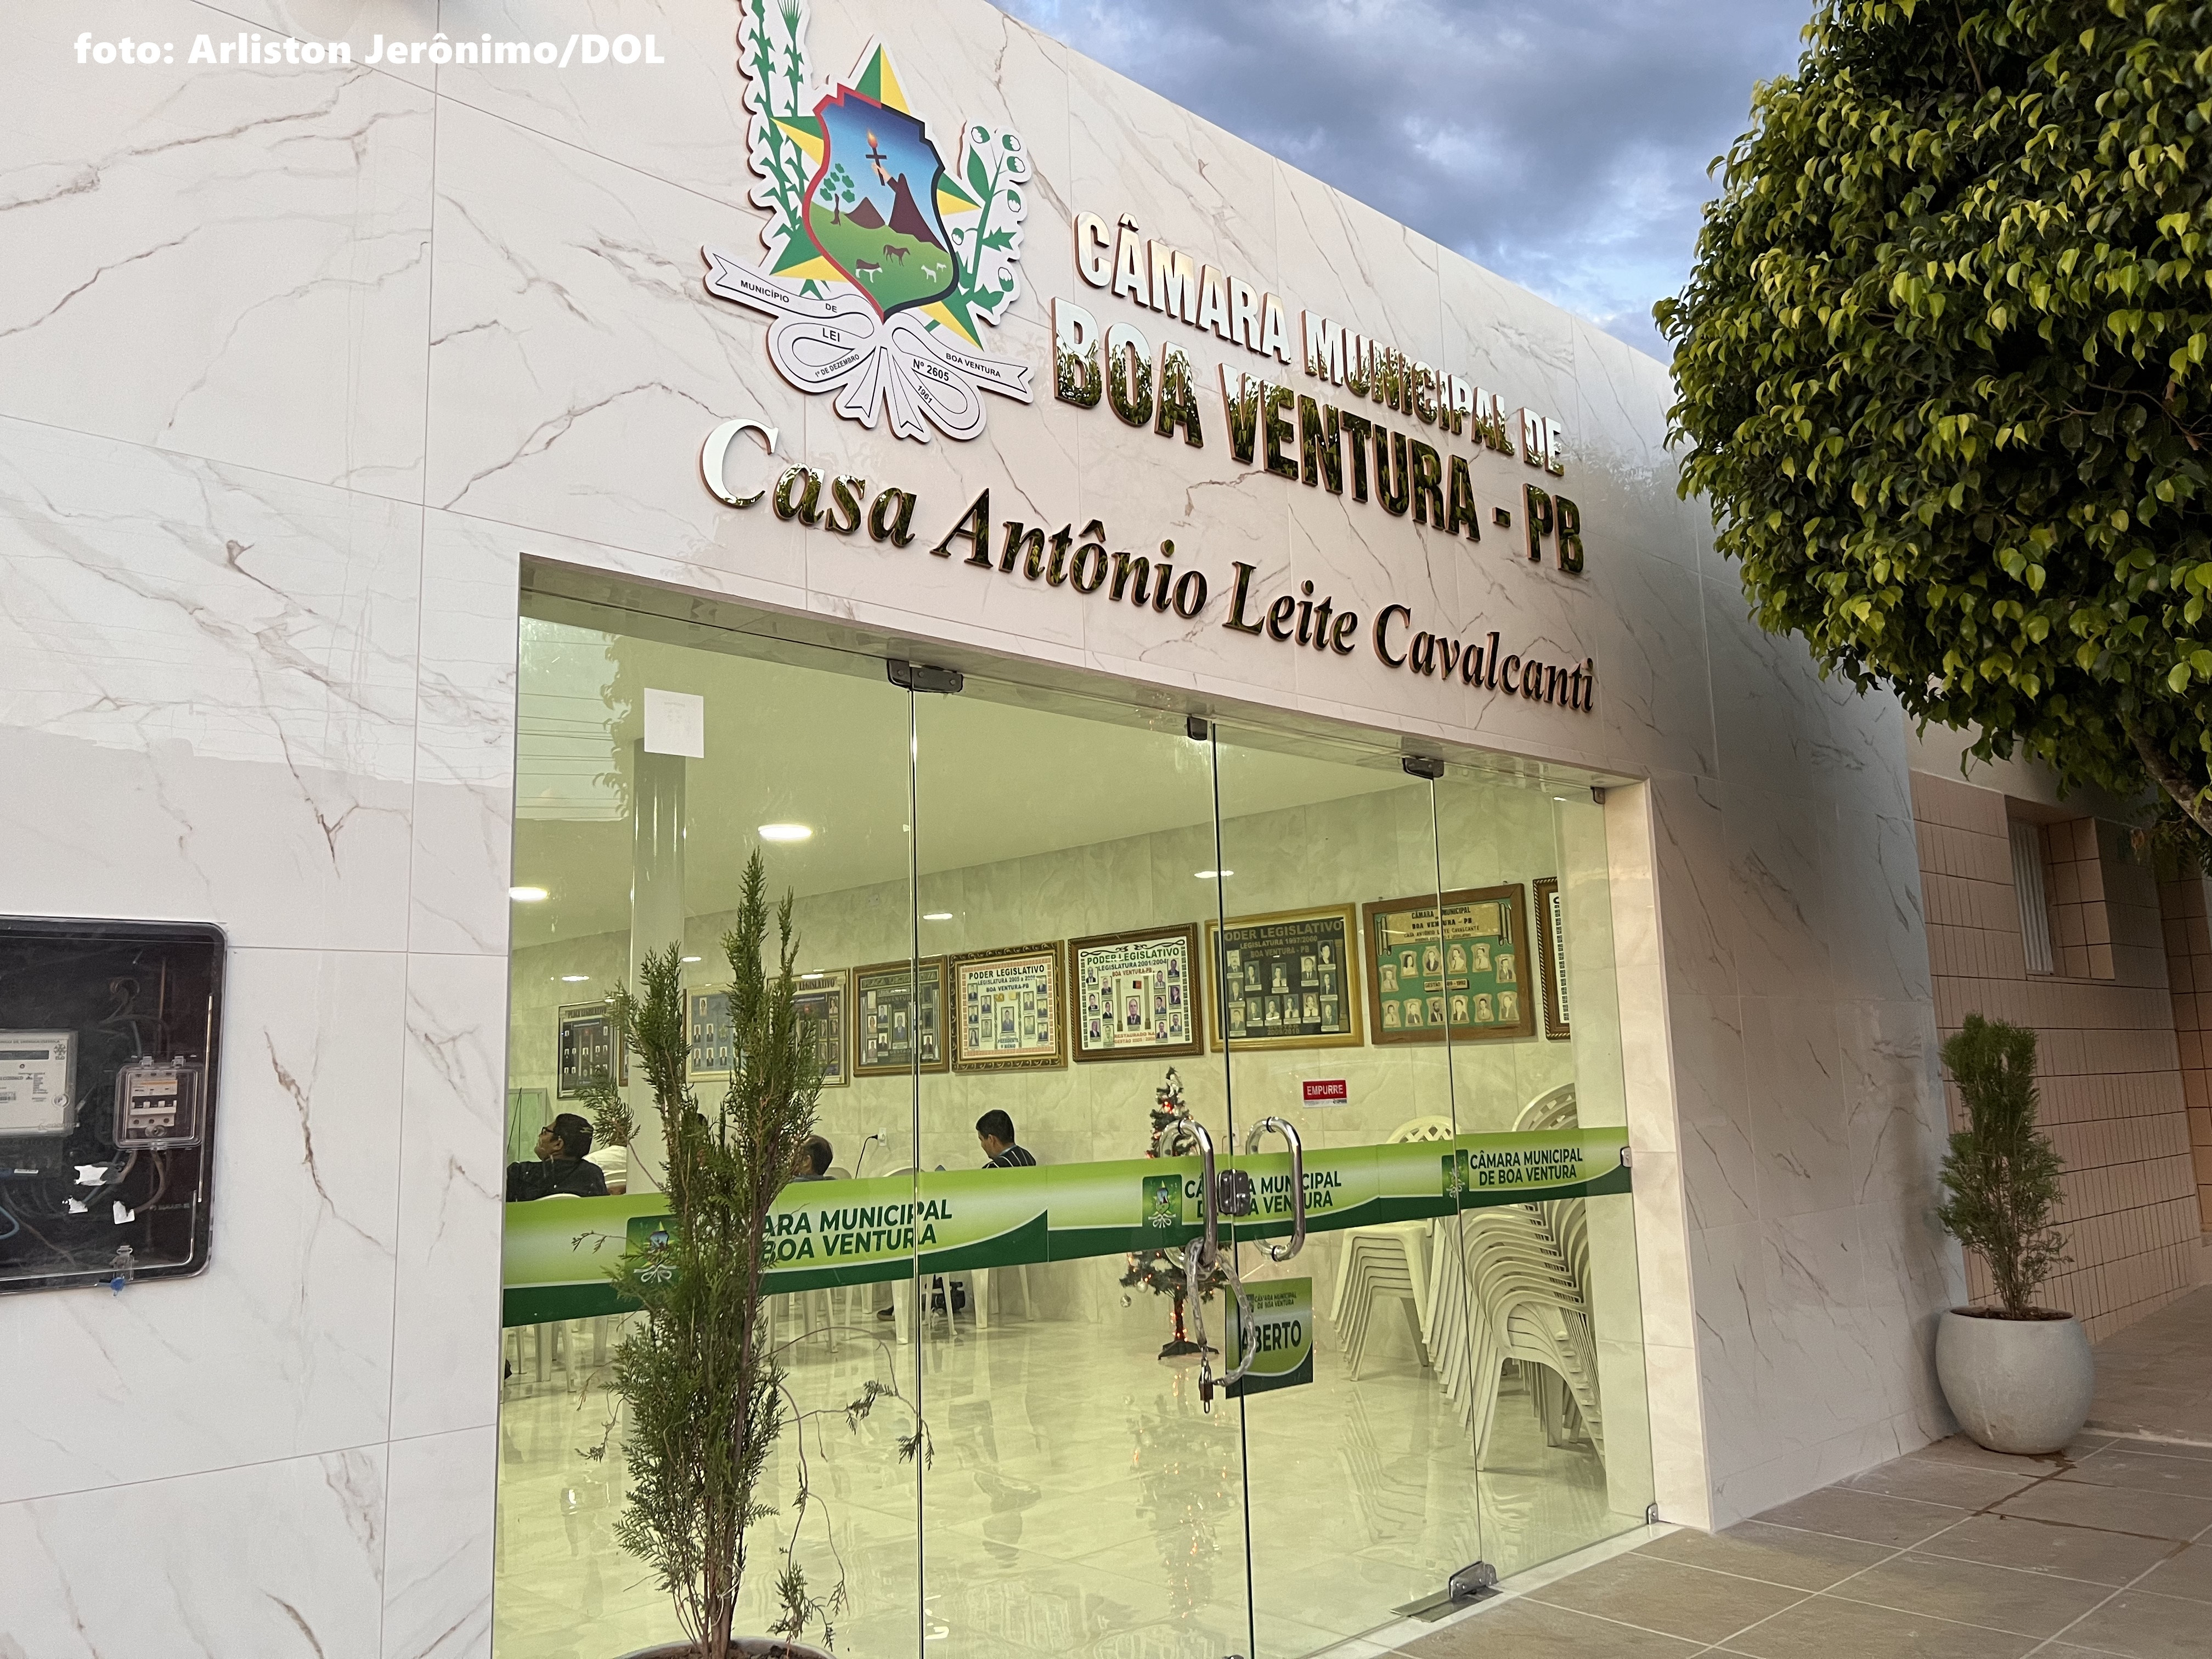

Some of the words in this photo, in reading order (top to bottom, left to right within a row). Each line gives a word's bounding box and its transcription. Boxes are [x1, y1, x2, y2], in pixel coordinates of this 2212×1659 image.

[741, 280, 789, 303] MUNICÍPIO
[825, 303, 837, 313] DE
[822, 328, 840, 342] LEI
[1075, 210, 1291, 365] CÂMARA
[1301, 308, 1515, 456] MUNICIPAL
[1520, 406, 1562, 476] DE
[829, 354, 860, 371] DEZEMBRO
[946, 353, 963, 365] BOA
[964, 359, 1001, 378] VENTURA
[927, 365, 950, 381] 2605
[918, 385, 933, 404] 1961
[1051, 296, 1204, 448] BOA
[1218, 362, 1480, 542] VENTURA
[1522, 483, 1584, 574] PB
[699, 417, 918, 548] Casa
[930, 487, 1208, 619] Antônio
[1222, 561, 1358, 655] Leite
[1372, 603, 1594, 714] Cavalcanti
[1224, 929, 1257, 942] ODER
[1260, 920, 1342, 939] LEGISLATIVO
[1426, 919, 1455, 928] VENURA
[1240, 940, 1284, 950] LEGISLATURA
[1265, 947, 1295, 957] VENTURA
[1300, 945, 1310, 953] PB
[1087, 955, 1117, 965] PODER
[1119, 947, 1180, 962] LEGISLATIVO
[969, 970, 994, 980] PODER
[996, 964, 1045, 977] LEGISLATIVO
[1098, 962, 1137, 971] LEGISLATURA
[978, 977, 1008, 985] LEGISLATURA
[1306, 1084, 1344, 1096] EMPURRE
[1470, 1150, 1521, 1170] CÂMARA
[1523, 1148, 1583, 1164] MUNICIPAL
[1261, 1171, 1342, 1195] MUNCIPAL
[1479, 1170, 1495, 1186] DE
[1498, 1167, 1523, 1184] BOA
[1525, 1164, 1577, 1182] VENTURA
[1263, 1190, 1334, 1214] VENURA
[820, 1199, 953, 1233] MUNICIPAL
[822, 1223, 936, 1256] VENTURA
